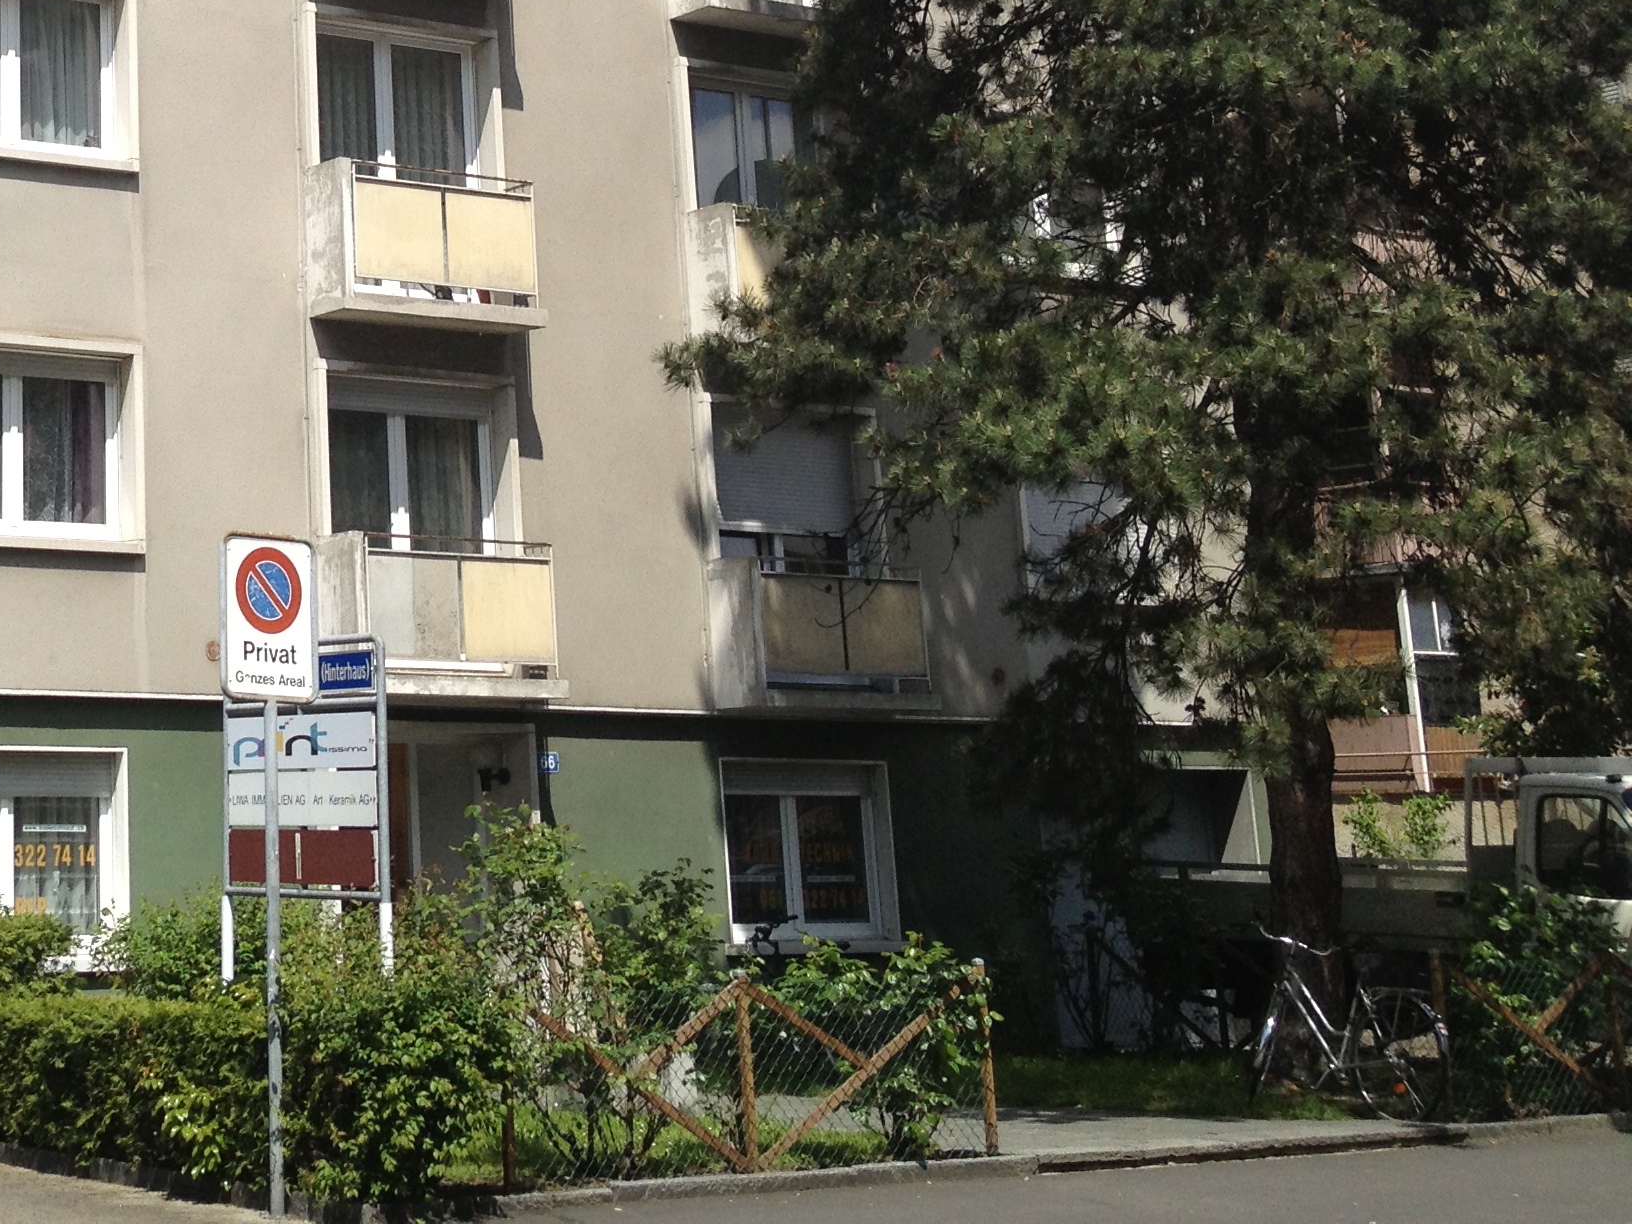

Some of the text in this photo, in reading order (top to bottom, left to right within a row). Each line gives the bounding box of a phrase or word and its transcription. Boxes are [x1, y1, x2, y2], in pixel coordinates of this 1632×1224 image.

[243, 640, 297, 665] Privat
[278, 674, 306, 688] Areal
[321, 657, 370, 684] (Hinterhaus)
[233, 718, 328, 767] pint
[295, 794, 306, 806] AG
[329, 794, 357, 806] Keramik
[358, 793, 370, 806] AG
[14, 843, 47, 868] 322
[52, 843, 72, 867] 74
[78, 843, 96, 867] 14
